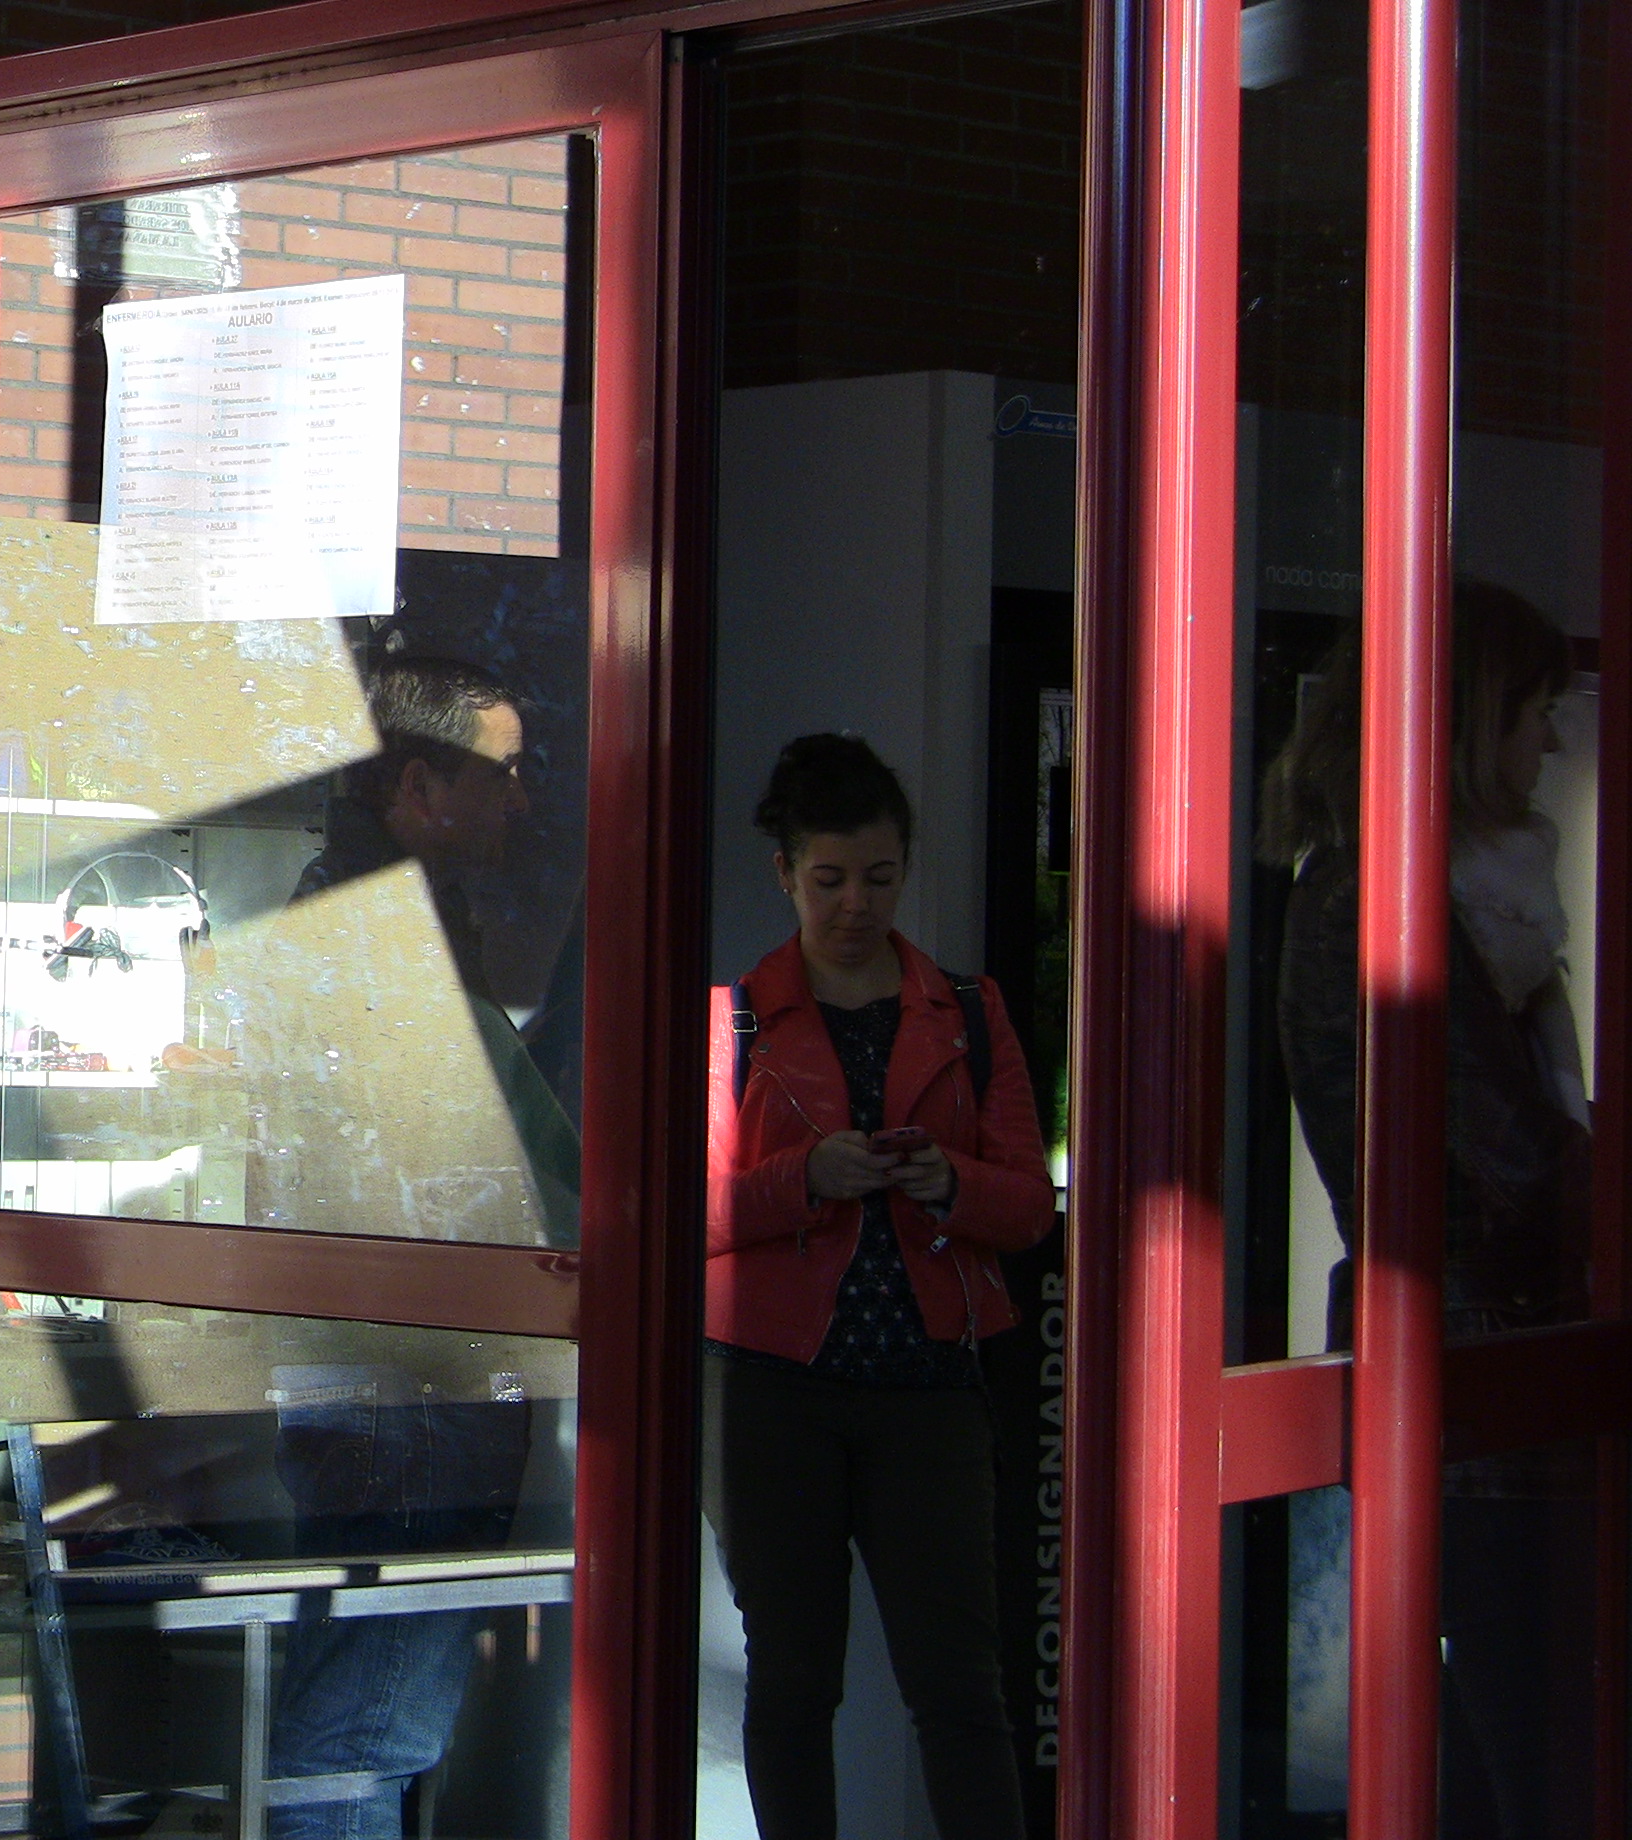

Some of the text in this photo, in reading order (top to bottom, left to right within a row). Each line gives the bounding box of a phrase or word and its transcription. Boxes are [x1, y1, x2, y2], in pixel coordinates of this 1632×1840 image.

[227, 312, 273, 328] AULARIO
[1265, 564, 1313, 588] nada
[1034, 1269, 1067, 1768] DECONSIGNADOR
